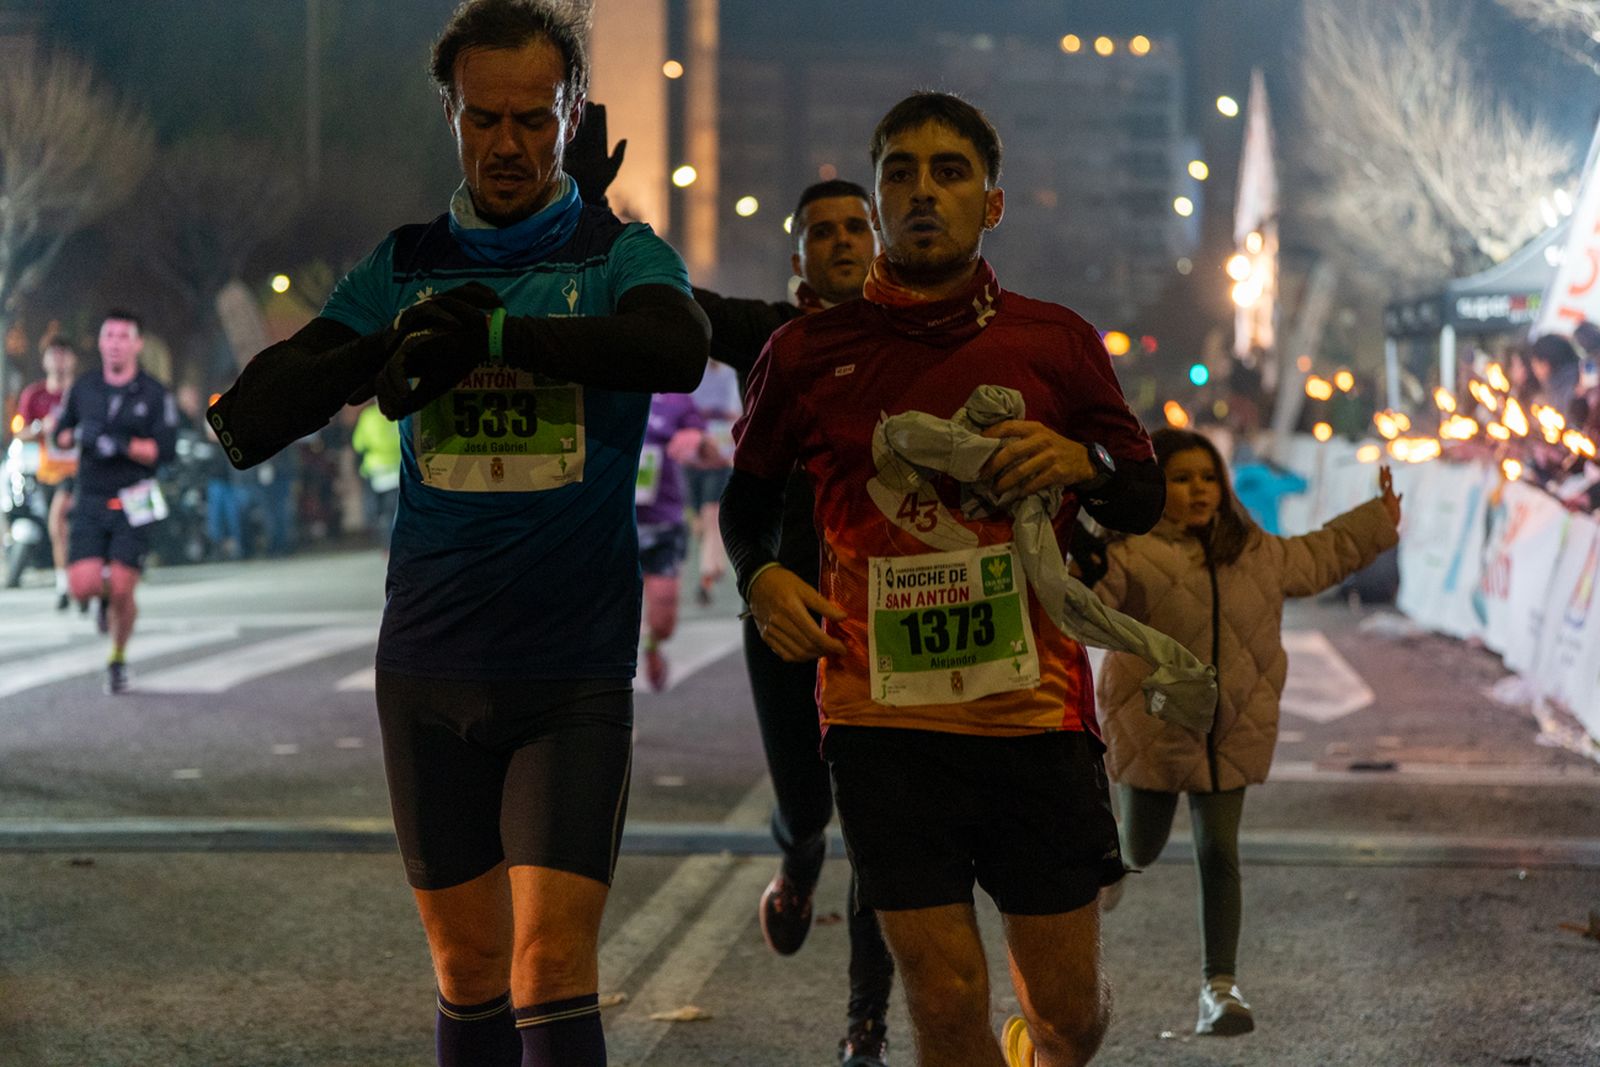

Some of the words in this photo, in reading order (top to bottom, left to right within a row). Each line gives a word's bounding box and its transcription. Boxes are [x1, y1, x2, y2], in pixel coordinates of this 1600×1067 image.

[453, 392, 537, 438] 533
[464, 441, 487, 453] José
[490, 441, 528, 453] Gabriel
[896, 492, 938, 532] 43
[897, 570, 945, 589] NOCHE
[949, 568, 967, 584] DE
[885, 592, 911, 609] SAN
[916, 584, 970, 607] ANTÓN
[900, 602, 995, 656] 1373
[930, 653, 977, 669] Alejandro
